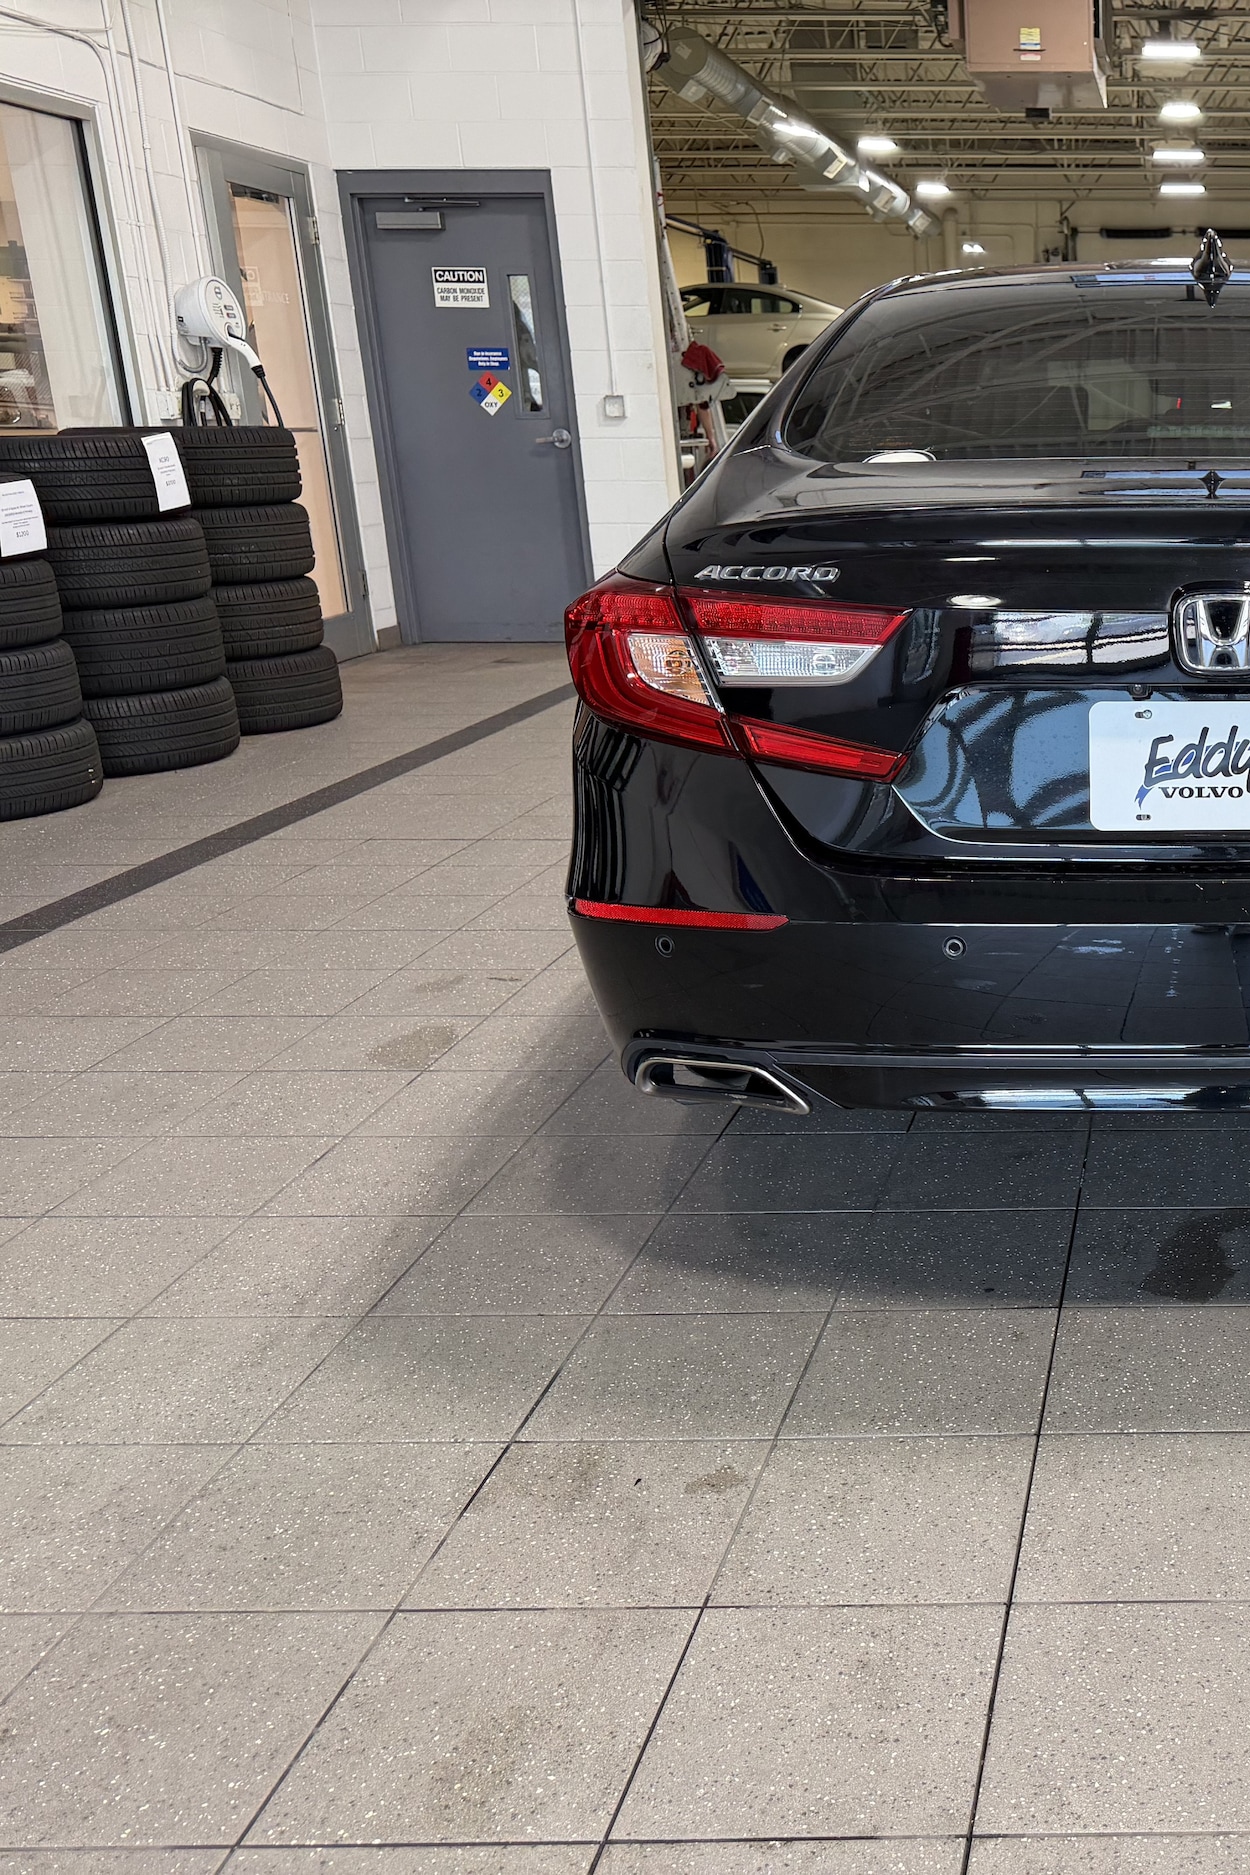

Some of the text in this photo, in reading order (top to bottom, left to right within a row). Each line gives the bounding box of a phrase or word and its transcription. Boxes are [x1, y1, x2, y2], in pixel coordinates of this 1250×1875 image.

[435, 270, 484, 282] CAUTION
[436, 287, 485, 295] CARBON MONOXIDE
[461, 295, 484, 303] PRESENT
[485, 377, 492, 386] 4
[476, 388, 504, 398] 2 3
[693, 564, 840, 582] ACCORD
[1157, 786, 1244, 799] VOLVO
